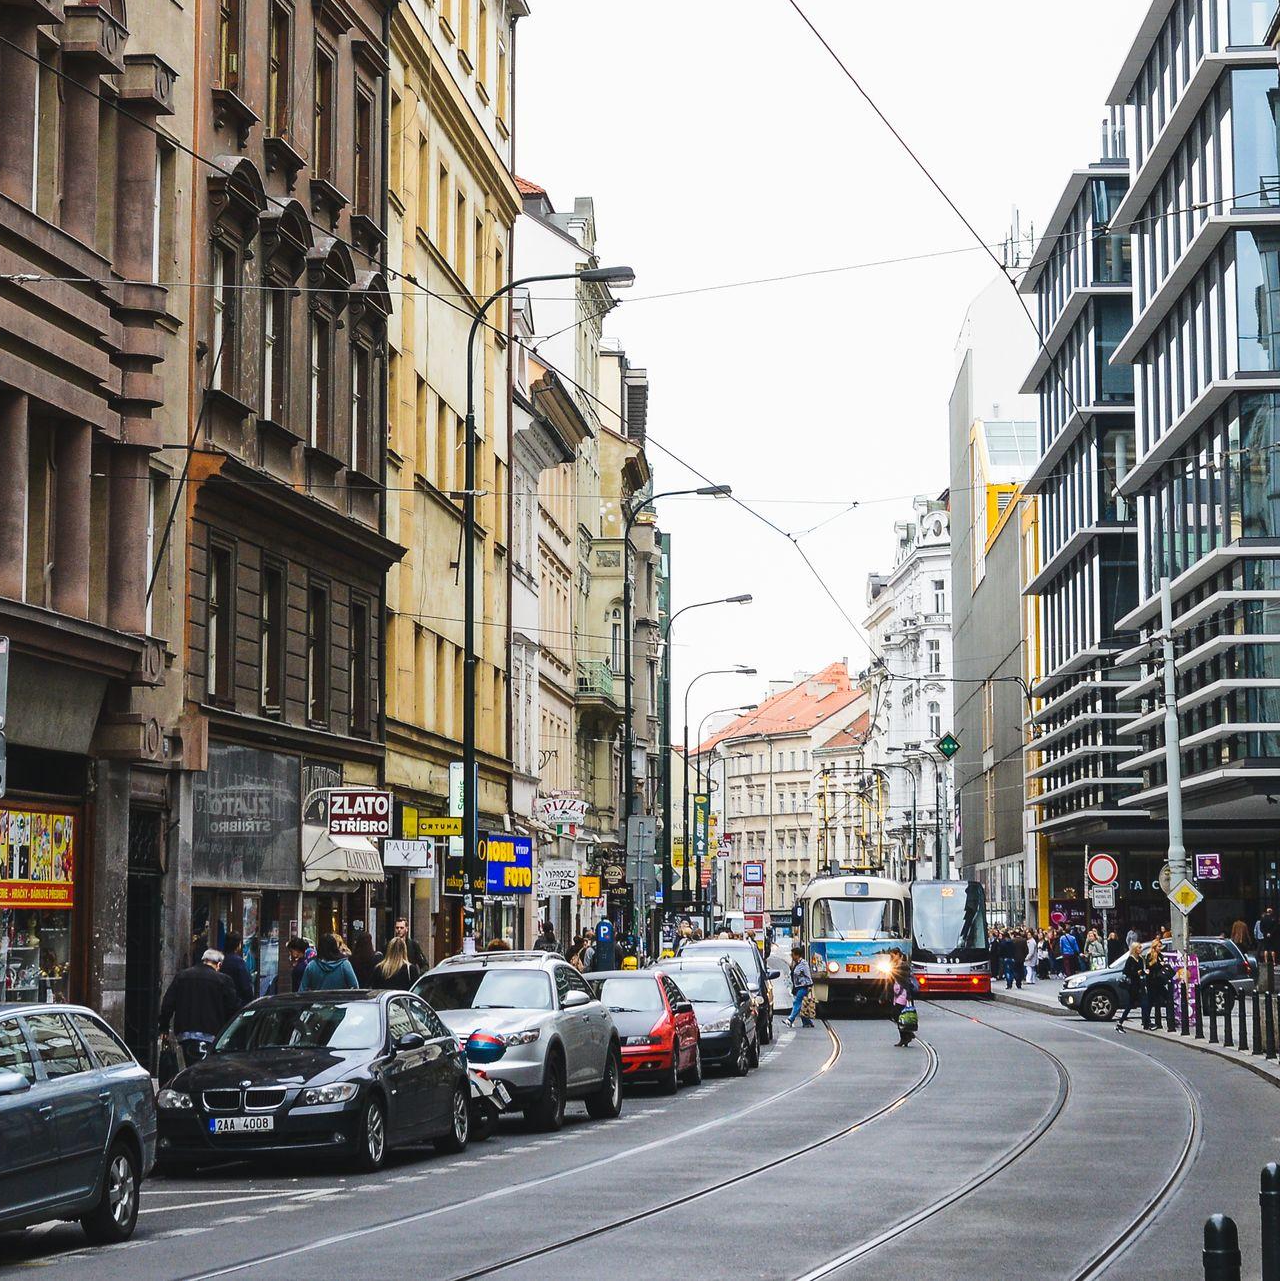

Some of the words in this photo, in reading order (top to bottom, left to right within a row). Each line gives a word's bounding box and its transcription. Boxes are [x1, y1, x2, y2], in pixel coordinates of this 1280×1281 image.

[331, 796, 389, 816] ZLATO
[543, 799, 587, 815] PIZZA
[330, 817, 389, 833] STŘÍBRO
[697, 805, 705, 840] SUBWAY
[385, 841, 428, 851] PAULA
[503, 866, 531, 887] FOTO
[941, 886, 955, 897] 22
[599, 925, 608, 938] P
[847, 964, 870, 973] 7121
[217, 1119, 235, 1131] 2AA
[243, 1117, 269, 1130] 4008
